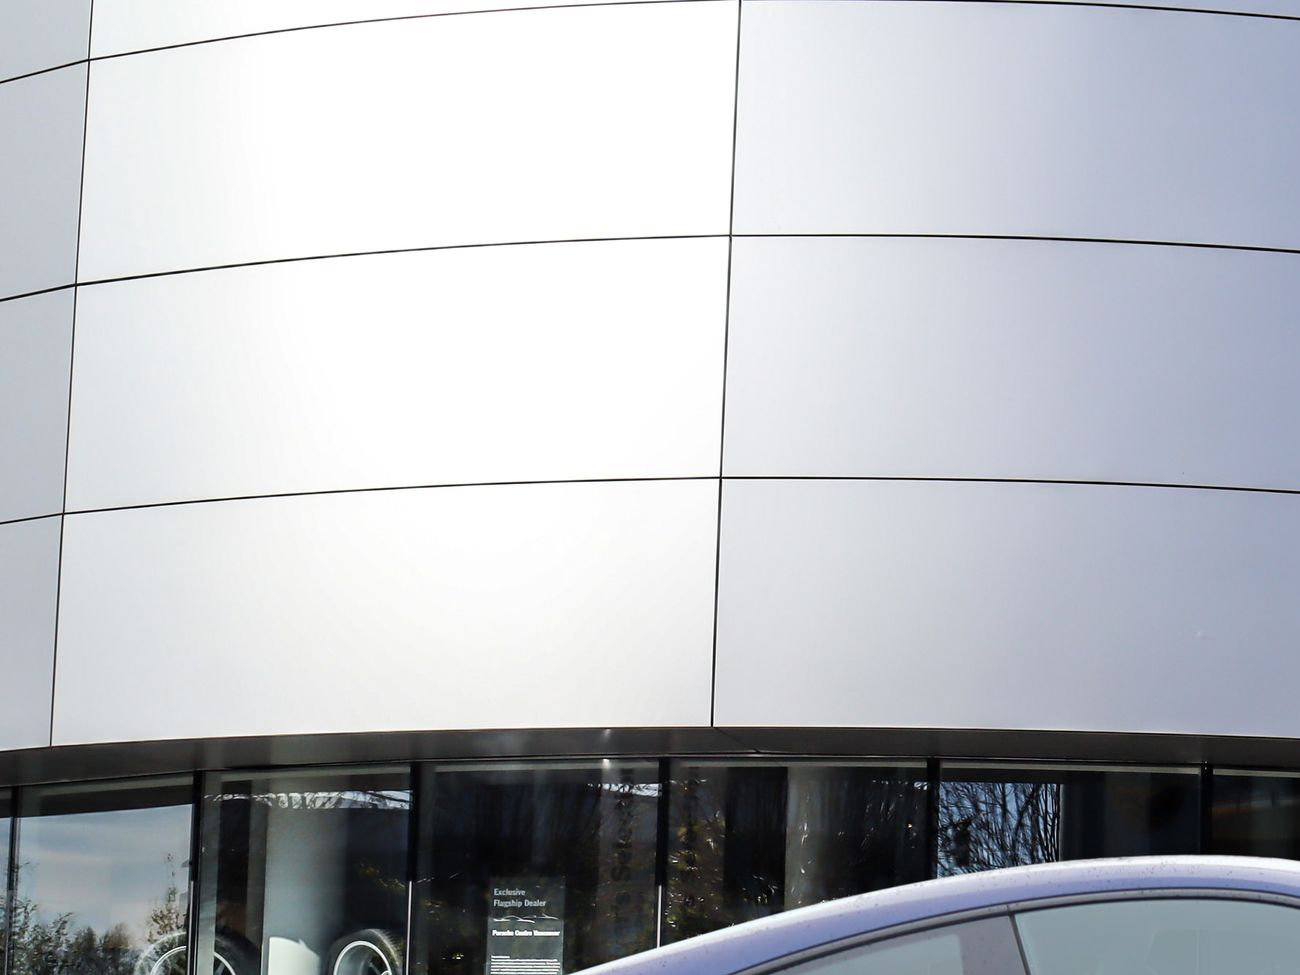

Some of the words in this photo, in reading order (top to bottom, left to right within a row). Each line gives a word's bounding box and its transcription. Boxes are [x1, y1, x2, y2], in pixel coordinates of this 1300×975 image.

[493, 888, 526, 896] Exclusive
[493, 899, 523, 908] Flagship
[524, 899, 547, 907] Dealer
